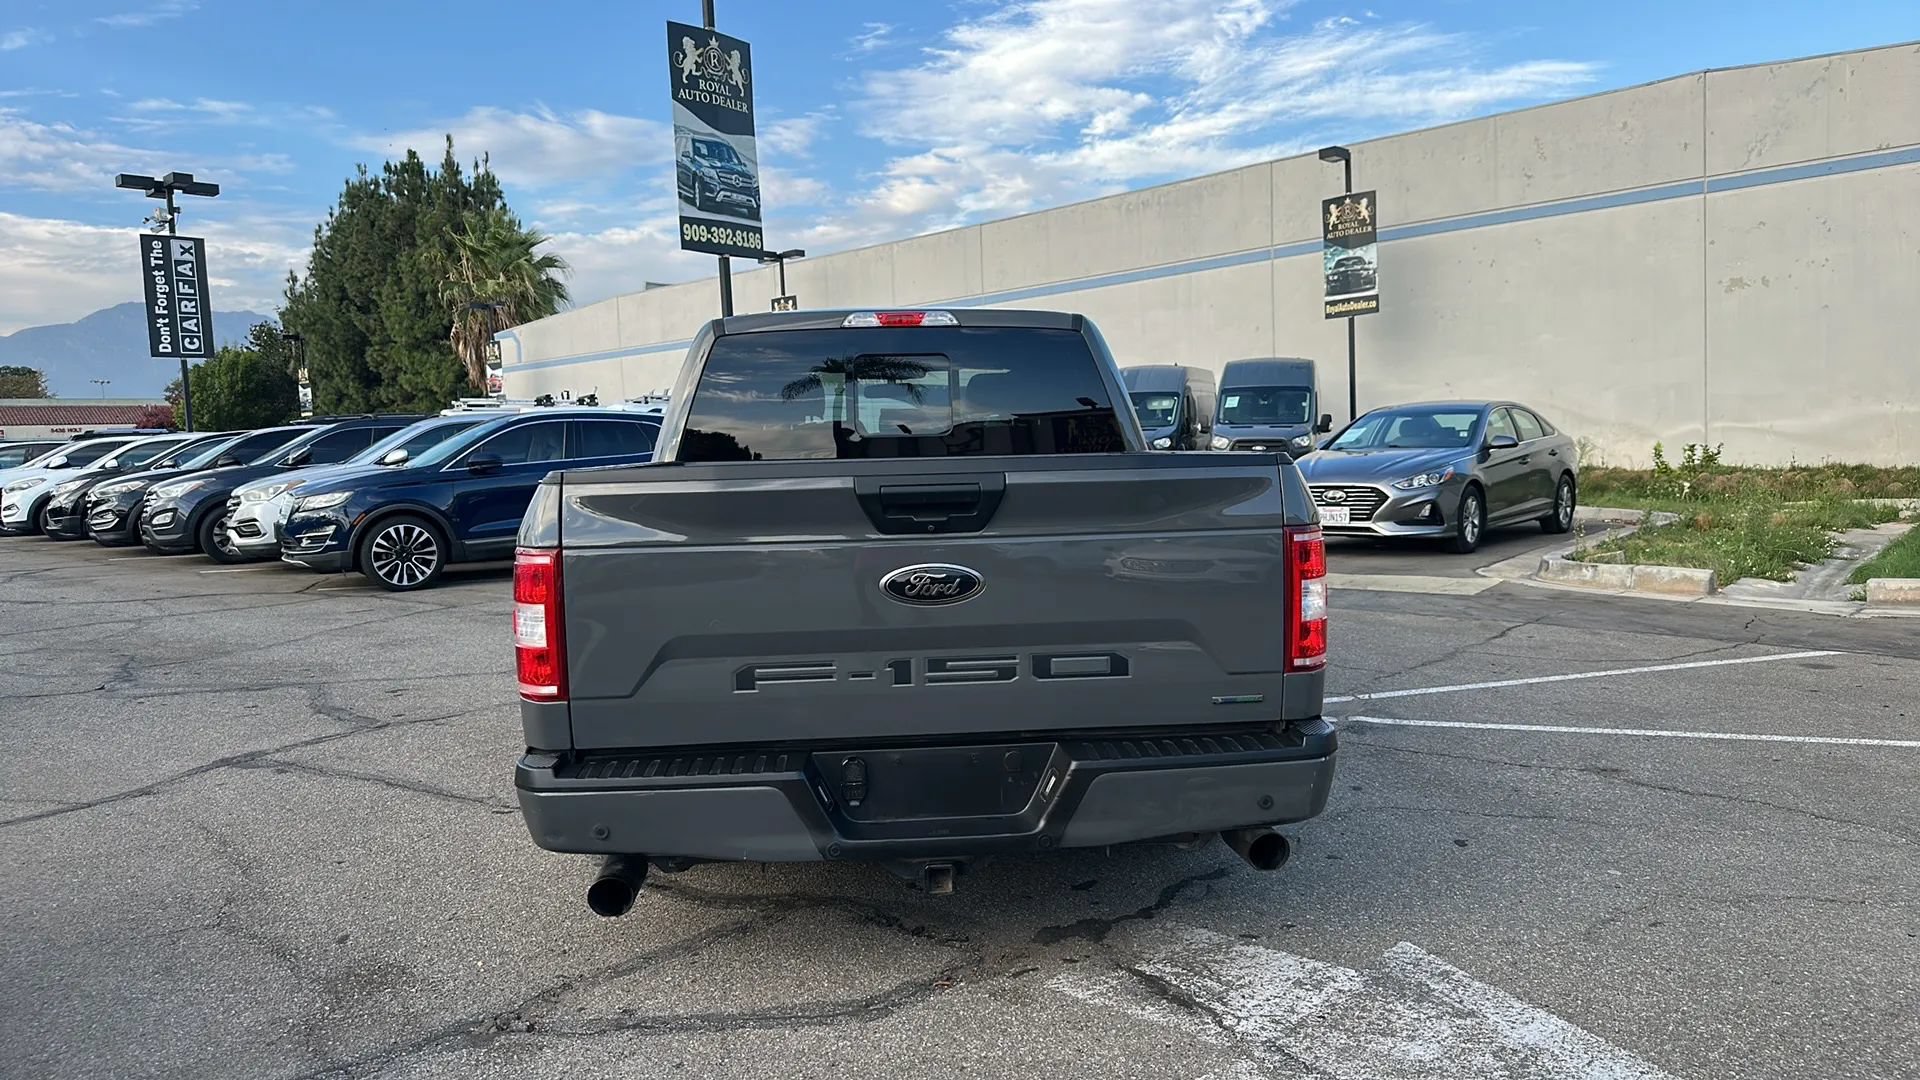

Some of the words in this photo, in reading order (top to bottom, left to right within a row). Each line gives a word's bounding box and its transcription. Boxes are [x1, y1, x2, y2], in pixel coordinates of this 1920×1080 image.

[678, 88, 710, 103] AUTO
[712, 95, 749, 113] DEALER
[699, 79, 732, 97] ROYAL
[682, 223, 762, 250] 909-392-8186
[1326, 229, 1345, 240] AUTO
[1344, 225, 1373, 237] DEALER
[1337, 221, 1360, 230] ROYAL
[150, 240, 165, 268] The
[152, 270, 170, 315] Forget
[176, 243, 201, 351] CARFAX
[156, 317, 172, 353] Don't
[905, 573, 961, 597] Ford
[733, 653, 1133, 693] F-150
